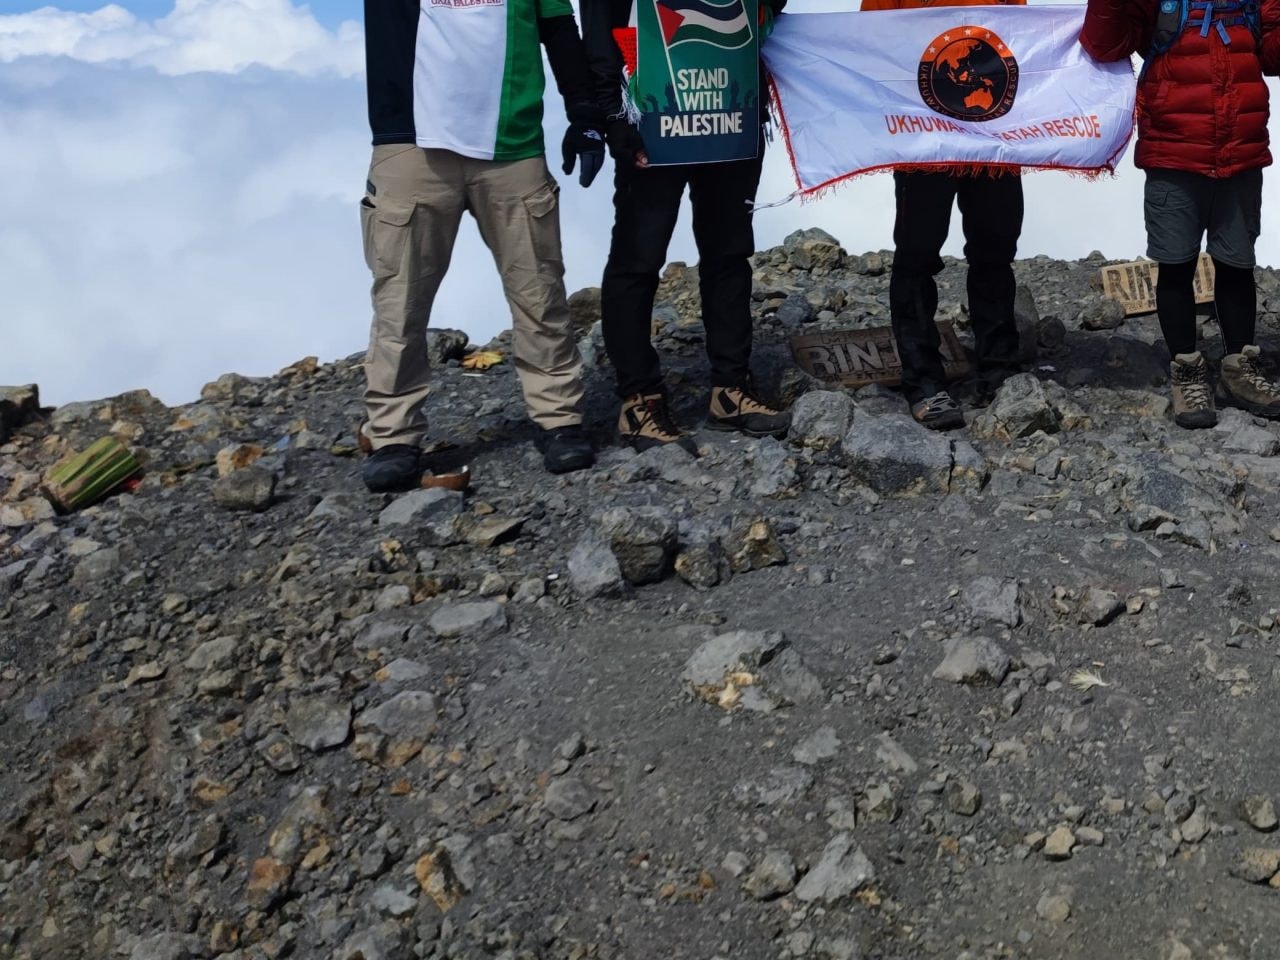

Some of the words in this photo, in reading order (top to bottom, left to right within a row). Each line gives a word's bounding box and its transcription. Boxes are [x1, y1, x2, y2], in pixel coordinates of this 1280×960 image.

[677, 68, 729, 90] STAND
[1003, 60, 1018, 106] RESCUE
[682, 91, 723, 111] WITH
[660, 111, 743, 138] PALESTINE
[1041, 115, 1102, 139] RESCUE
